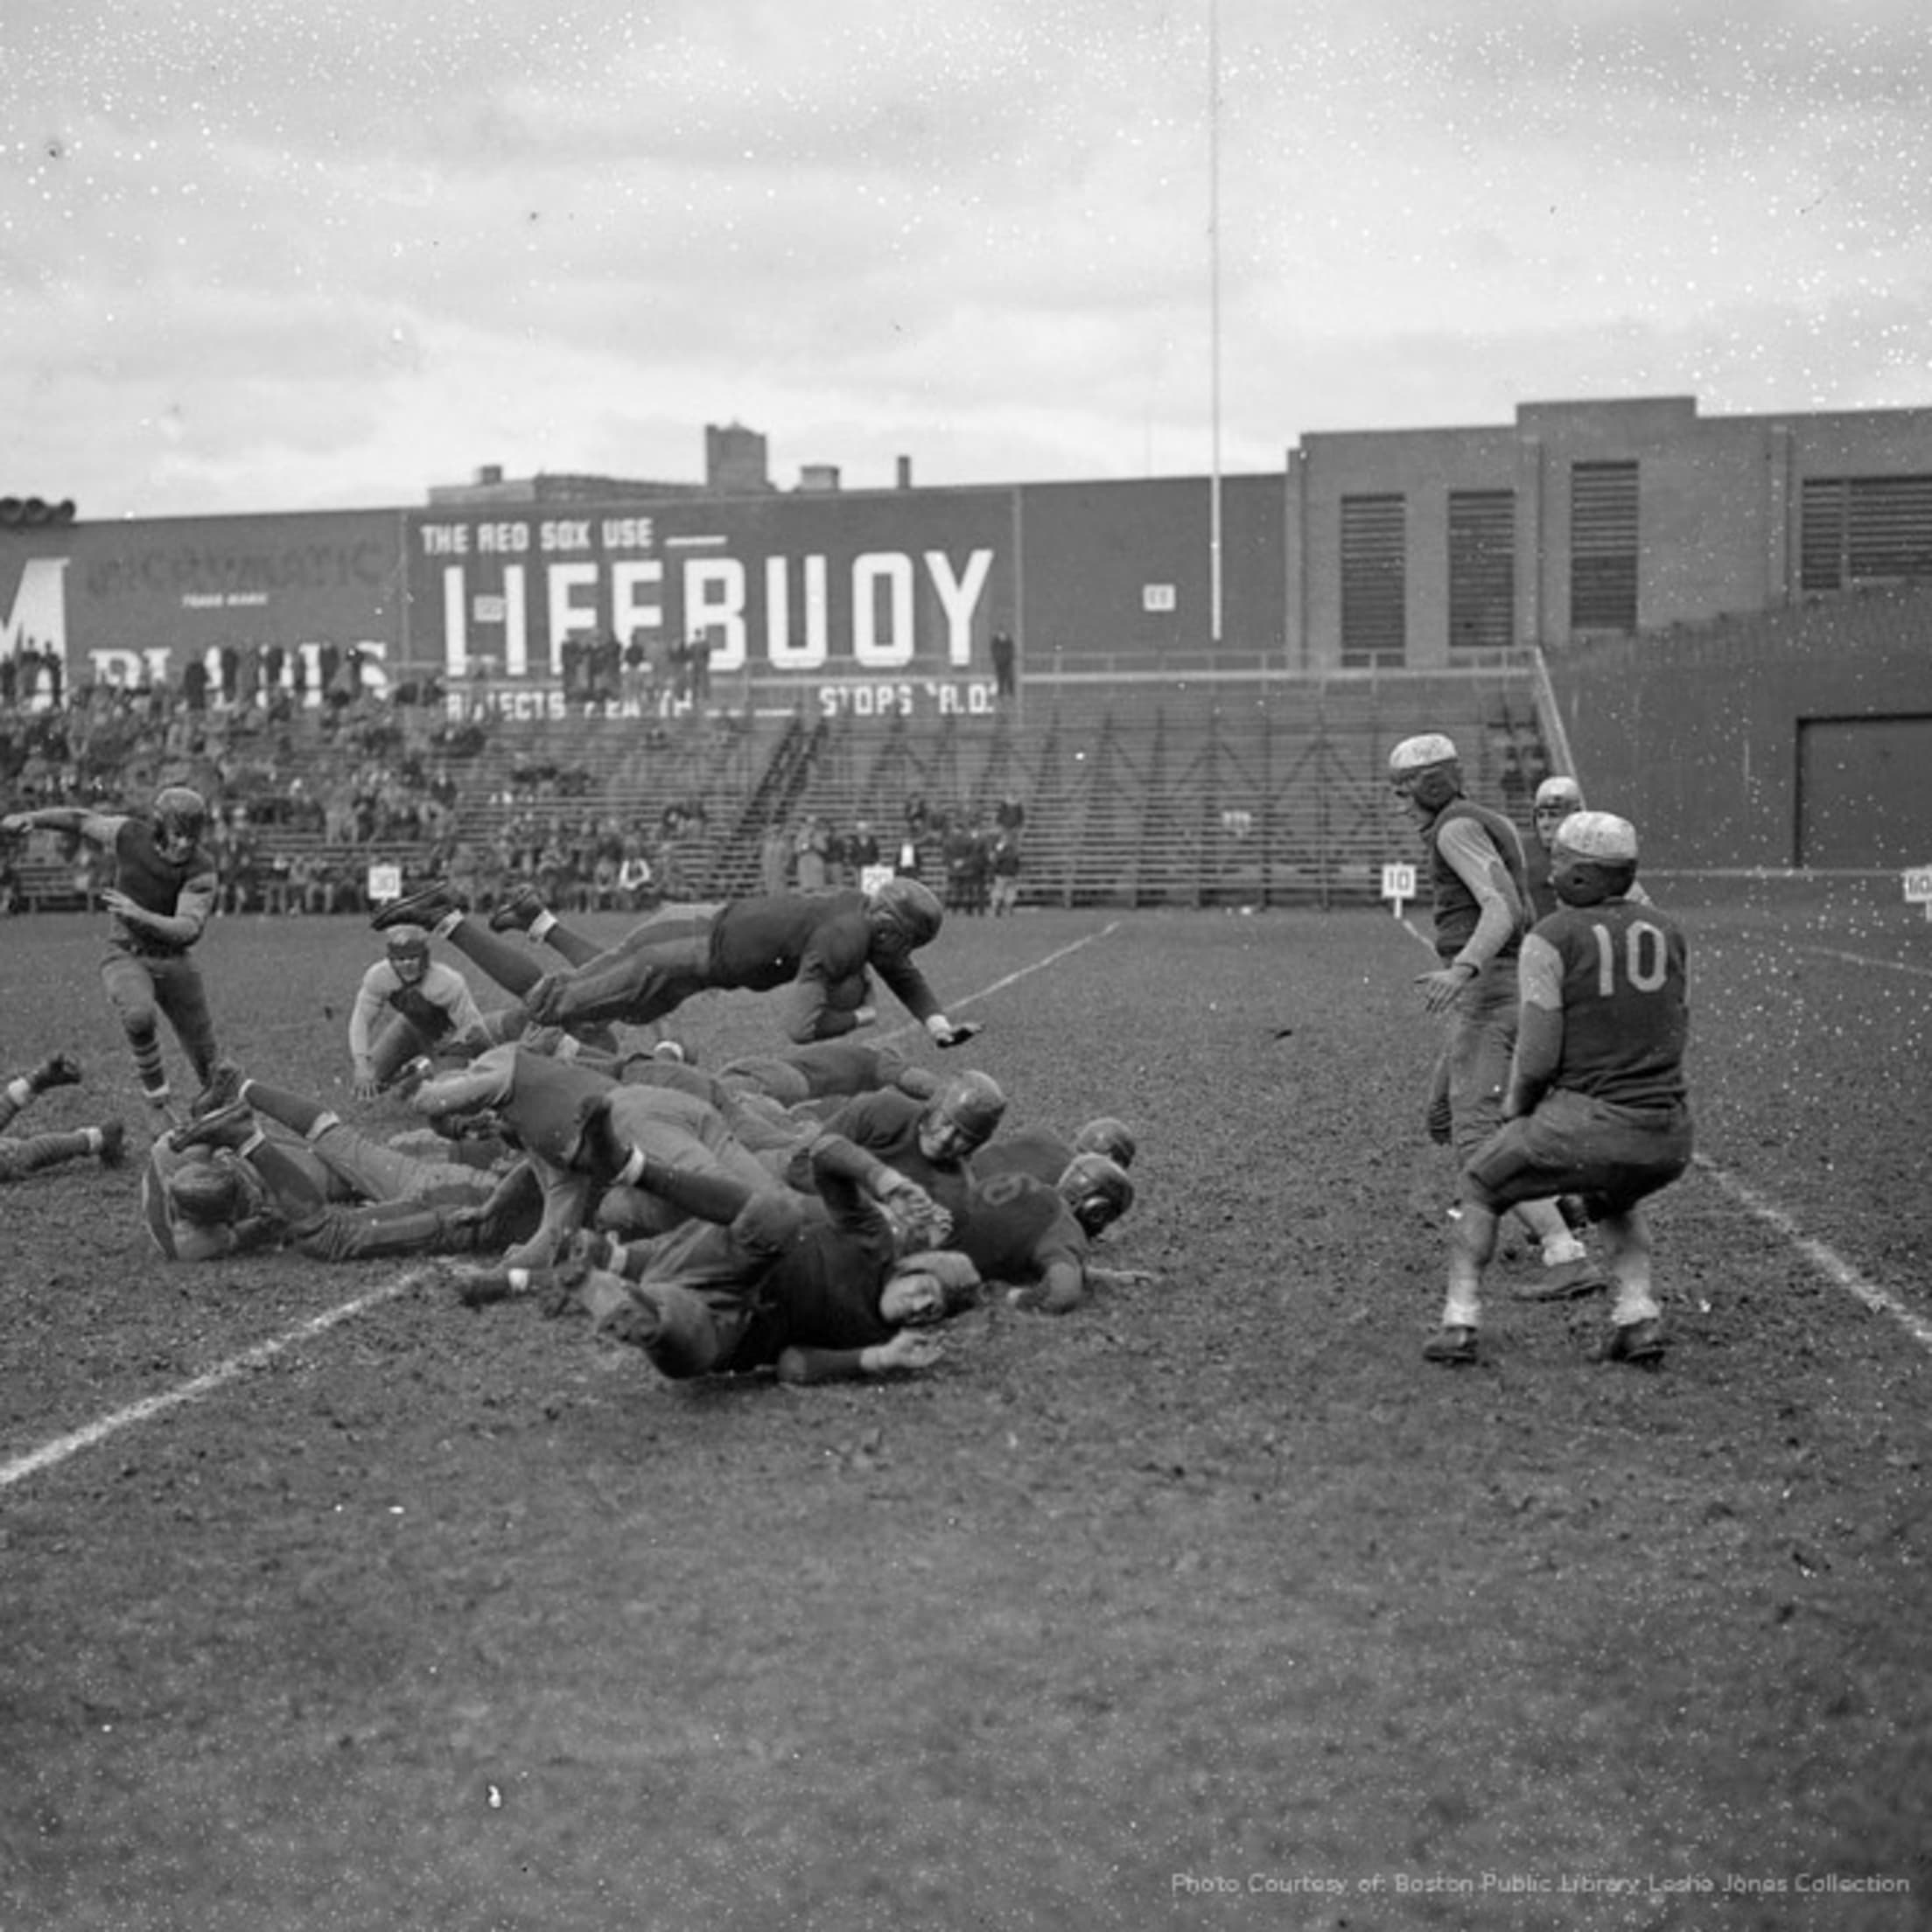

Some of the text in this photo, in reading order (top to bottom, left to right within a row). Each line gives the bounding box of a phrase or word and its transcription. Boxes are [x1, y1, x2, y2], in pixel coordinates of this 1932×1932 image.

[420, 517, 653, 554] THE RED SOX USE
[819, 684, 913, 716] STOPS
[1387, 870, 1411, 891] 10
[1592, 920, 1667, 997] 10
